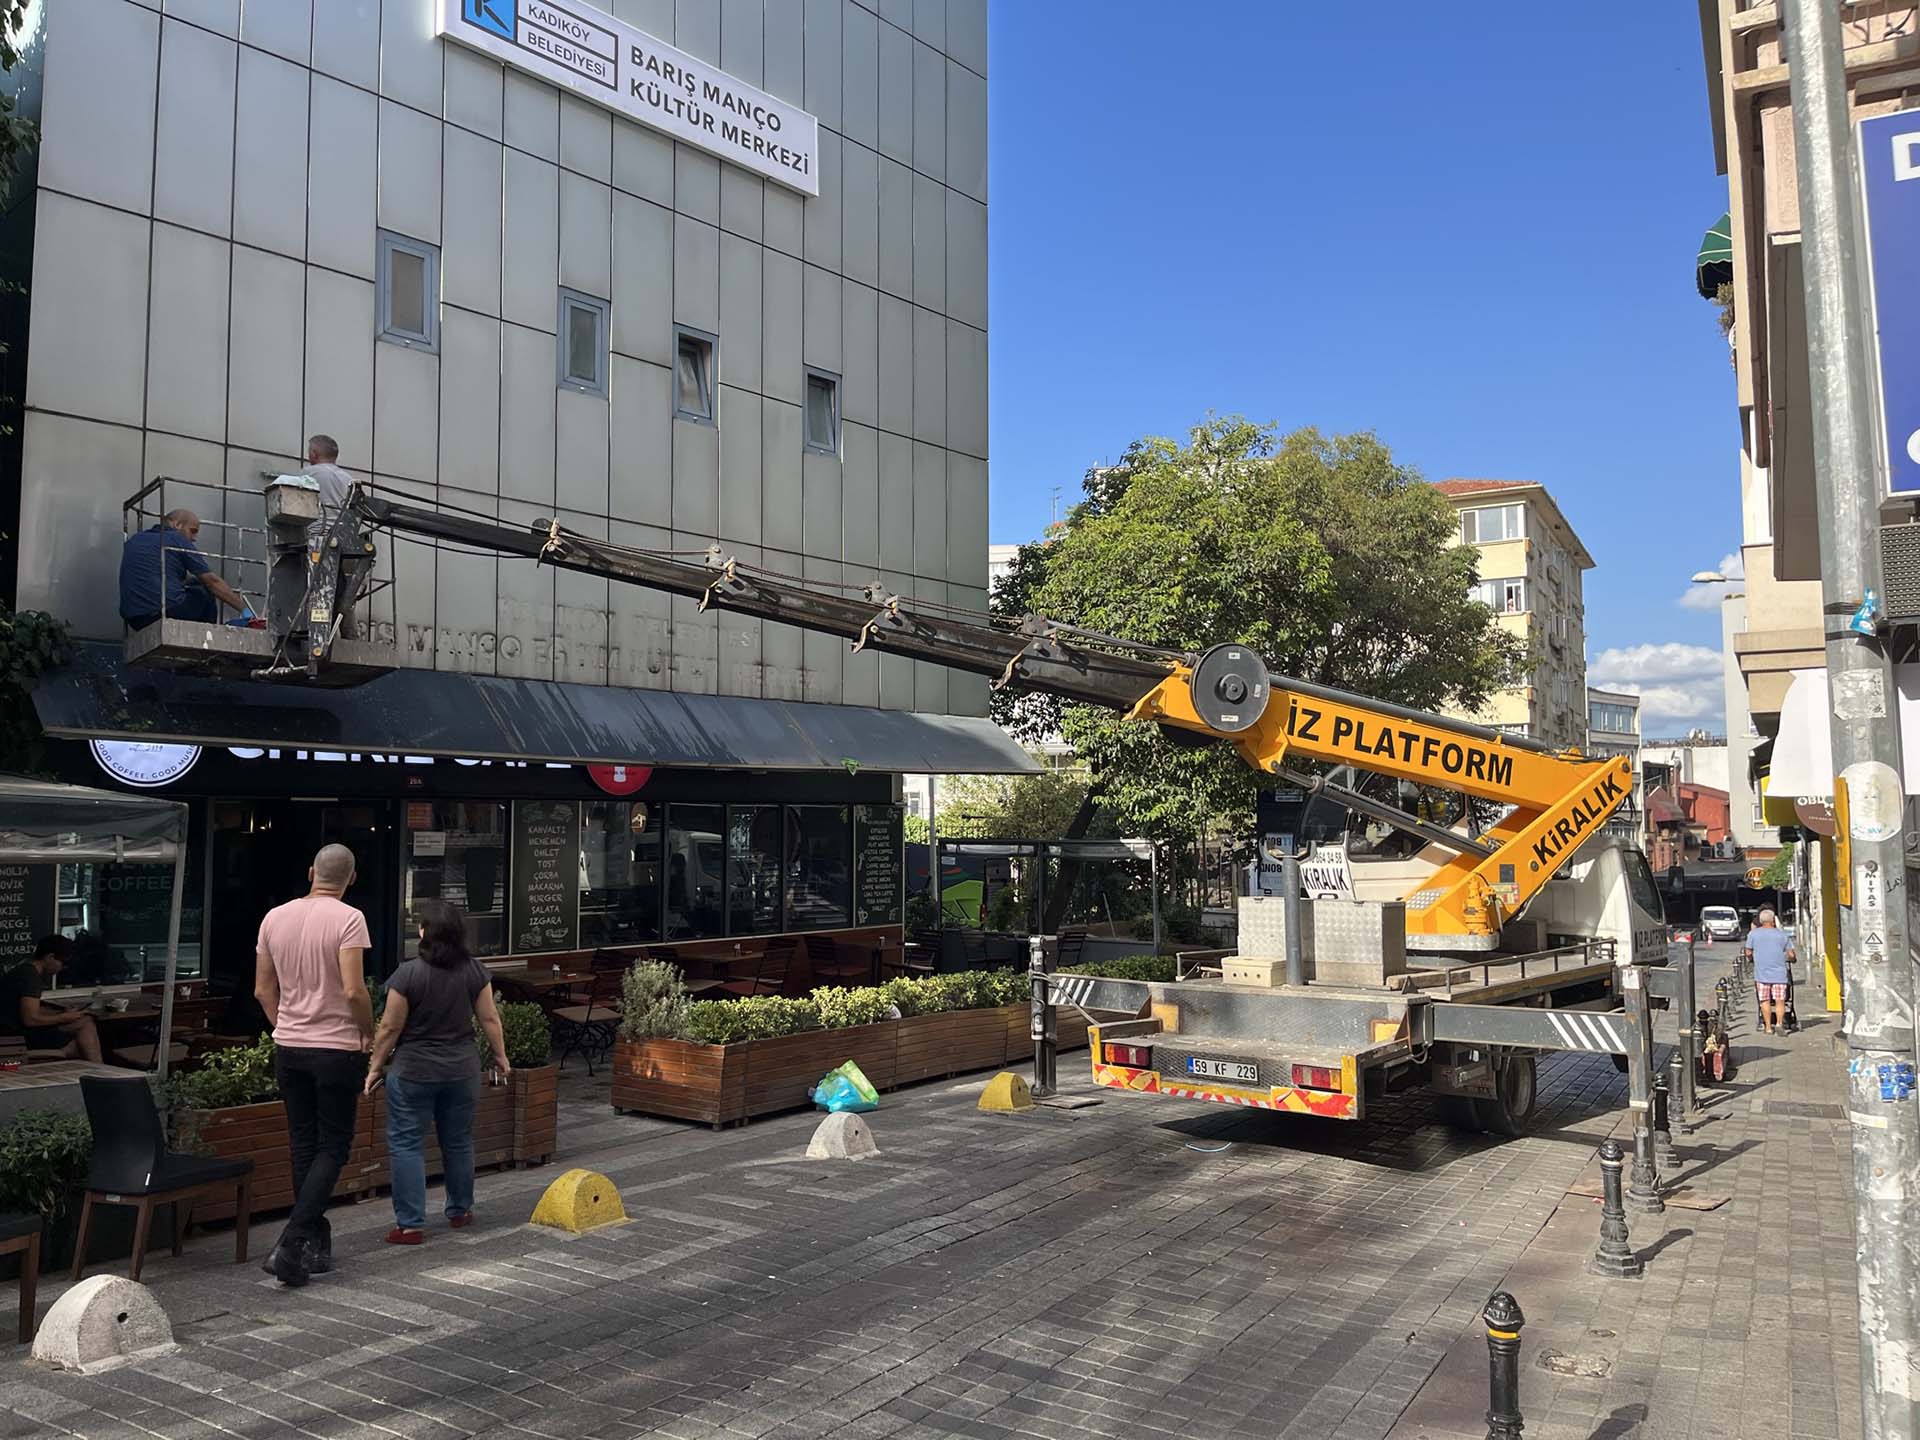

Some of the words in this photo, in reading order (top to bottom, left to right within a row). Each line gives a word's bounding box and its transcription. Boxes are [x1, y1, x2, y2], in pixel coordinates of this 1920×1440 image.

[528, 4, 590, 42] KADIKÖY
[528, 32, 607, 77] BELEDİYESİ
[630, 46, 695, 96] BARIŞ
[703, 80, 782, 133] MANÇO
[630, 77, 715, 134] KÜLTÜR
[721, 122, 809, 175] MERKEZİ
[1287, 698, 1322, 742] İZ
[1332, 715, 1514, 787] PLATFORM
[531, 905, 560, 914] SALATA
[1194, 1060, 1207, 1073] 59
[1214, 1062, 1227, 1076] KF
[1236, 1065, 1256, 1080] 229
